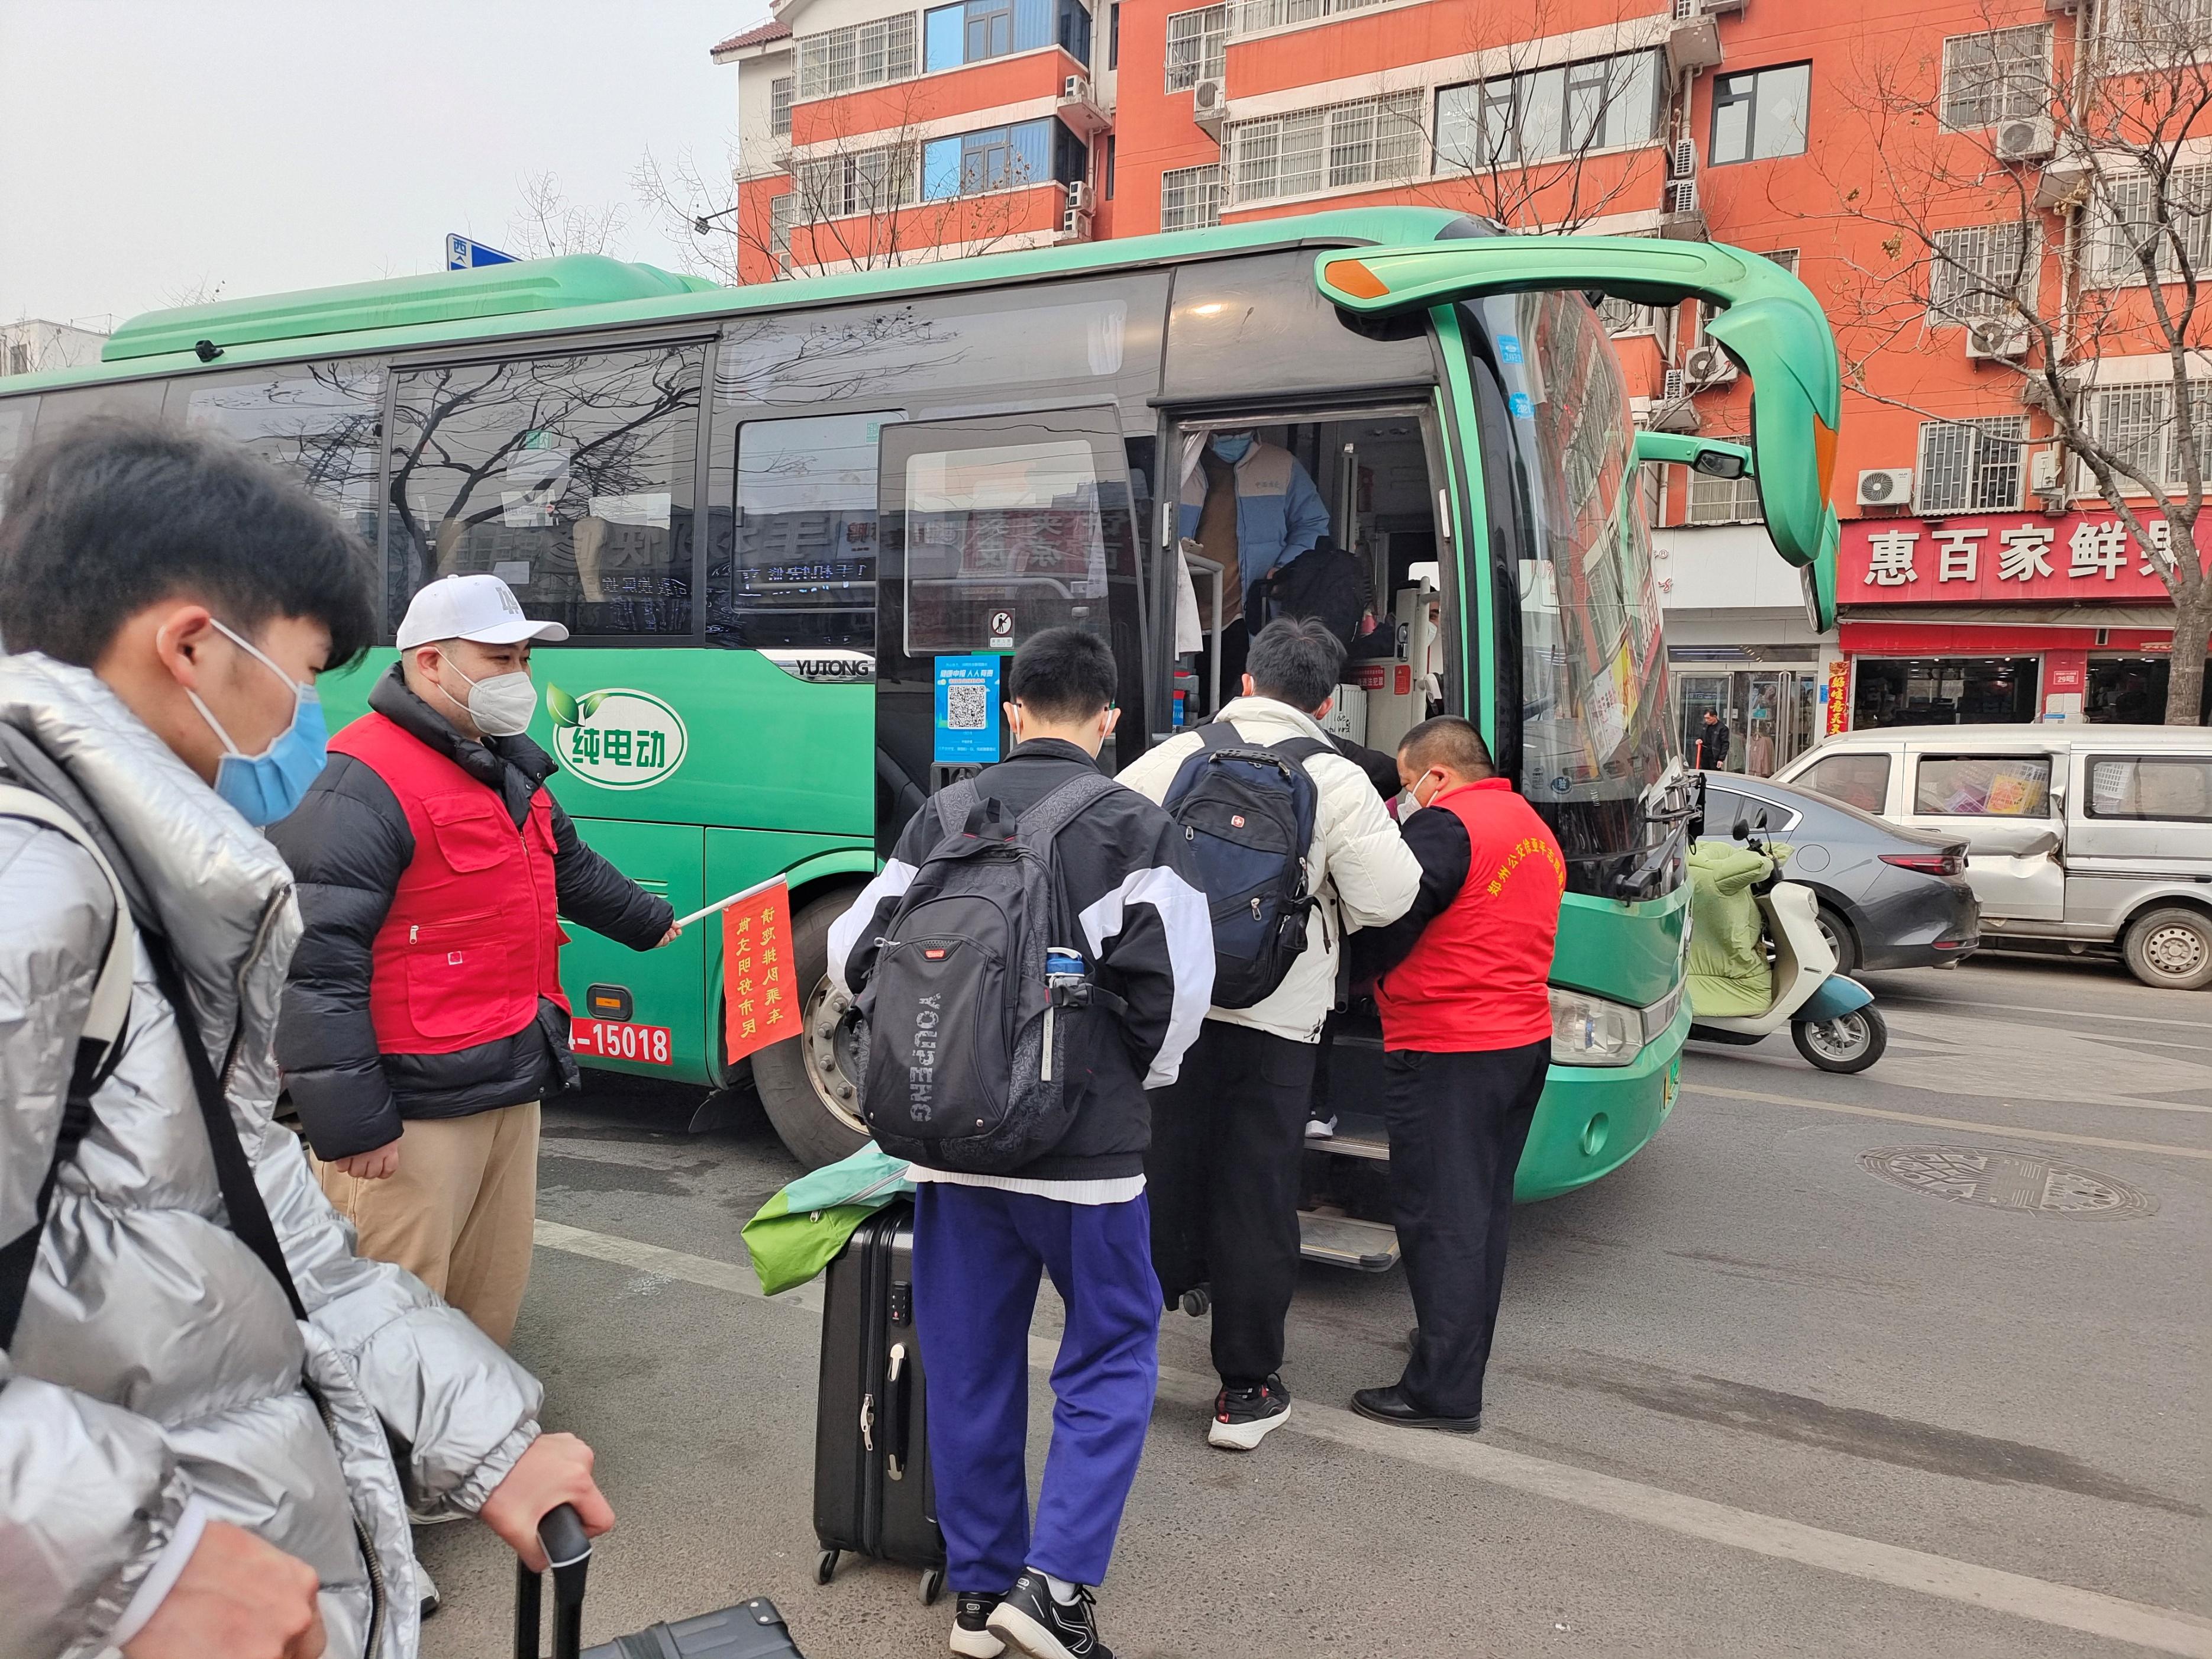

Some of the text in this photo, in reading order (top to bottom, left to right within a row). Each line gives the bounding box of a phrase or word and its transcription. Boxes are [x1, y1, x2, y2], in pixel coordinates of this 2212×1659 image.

[453, 237, 467, 256] 西
[796, 660, 869, 676] YUTONG
[572, 728, 665, 768] 纯电动
[910, 993, 941, 1122] YOUPENG
